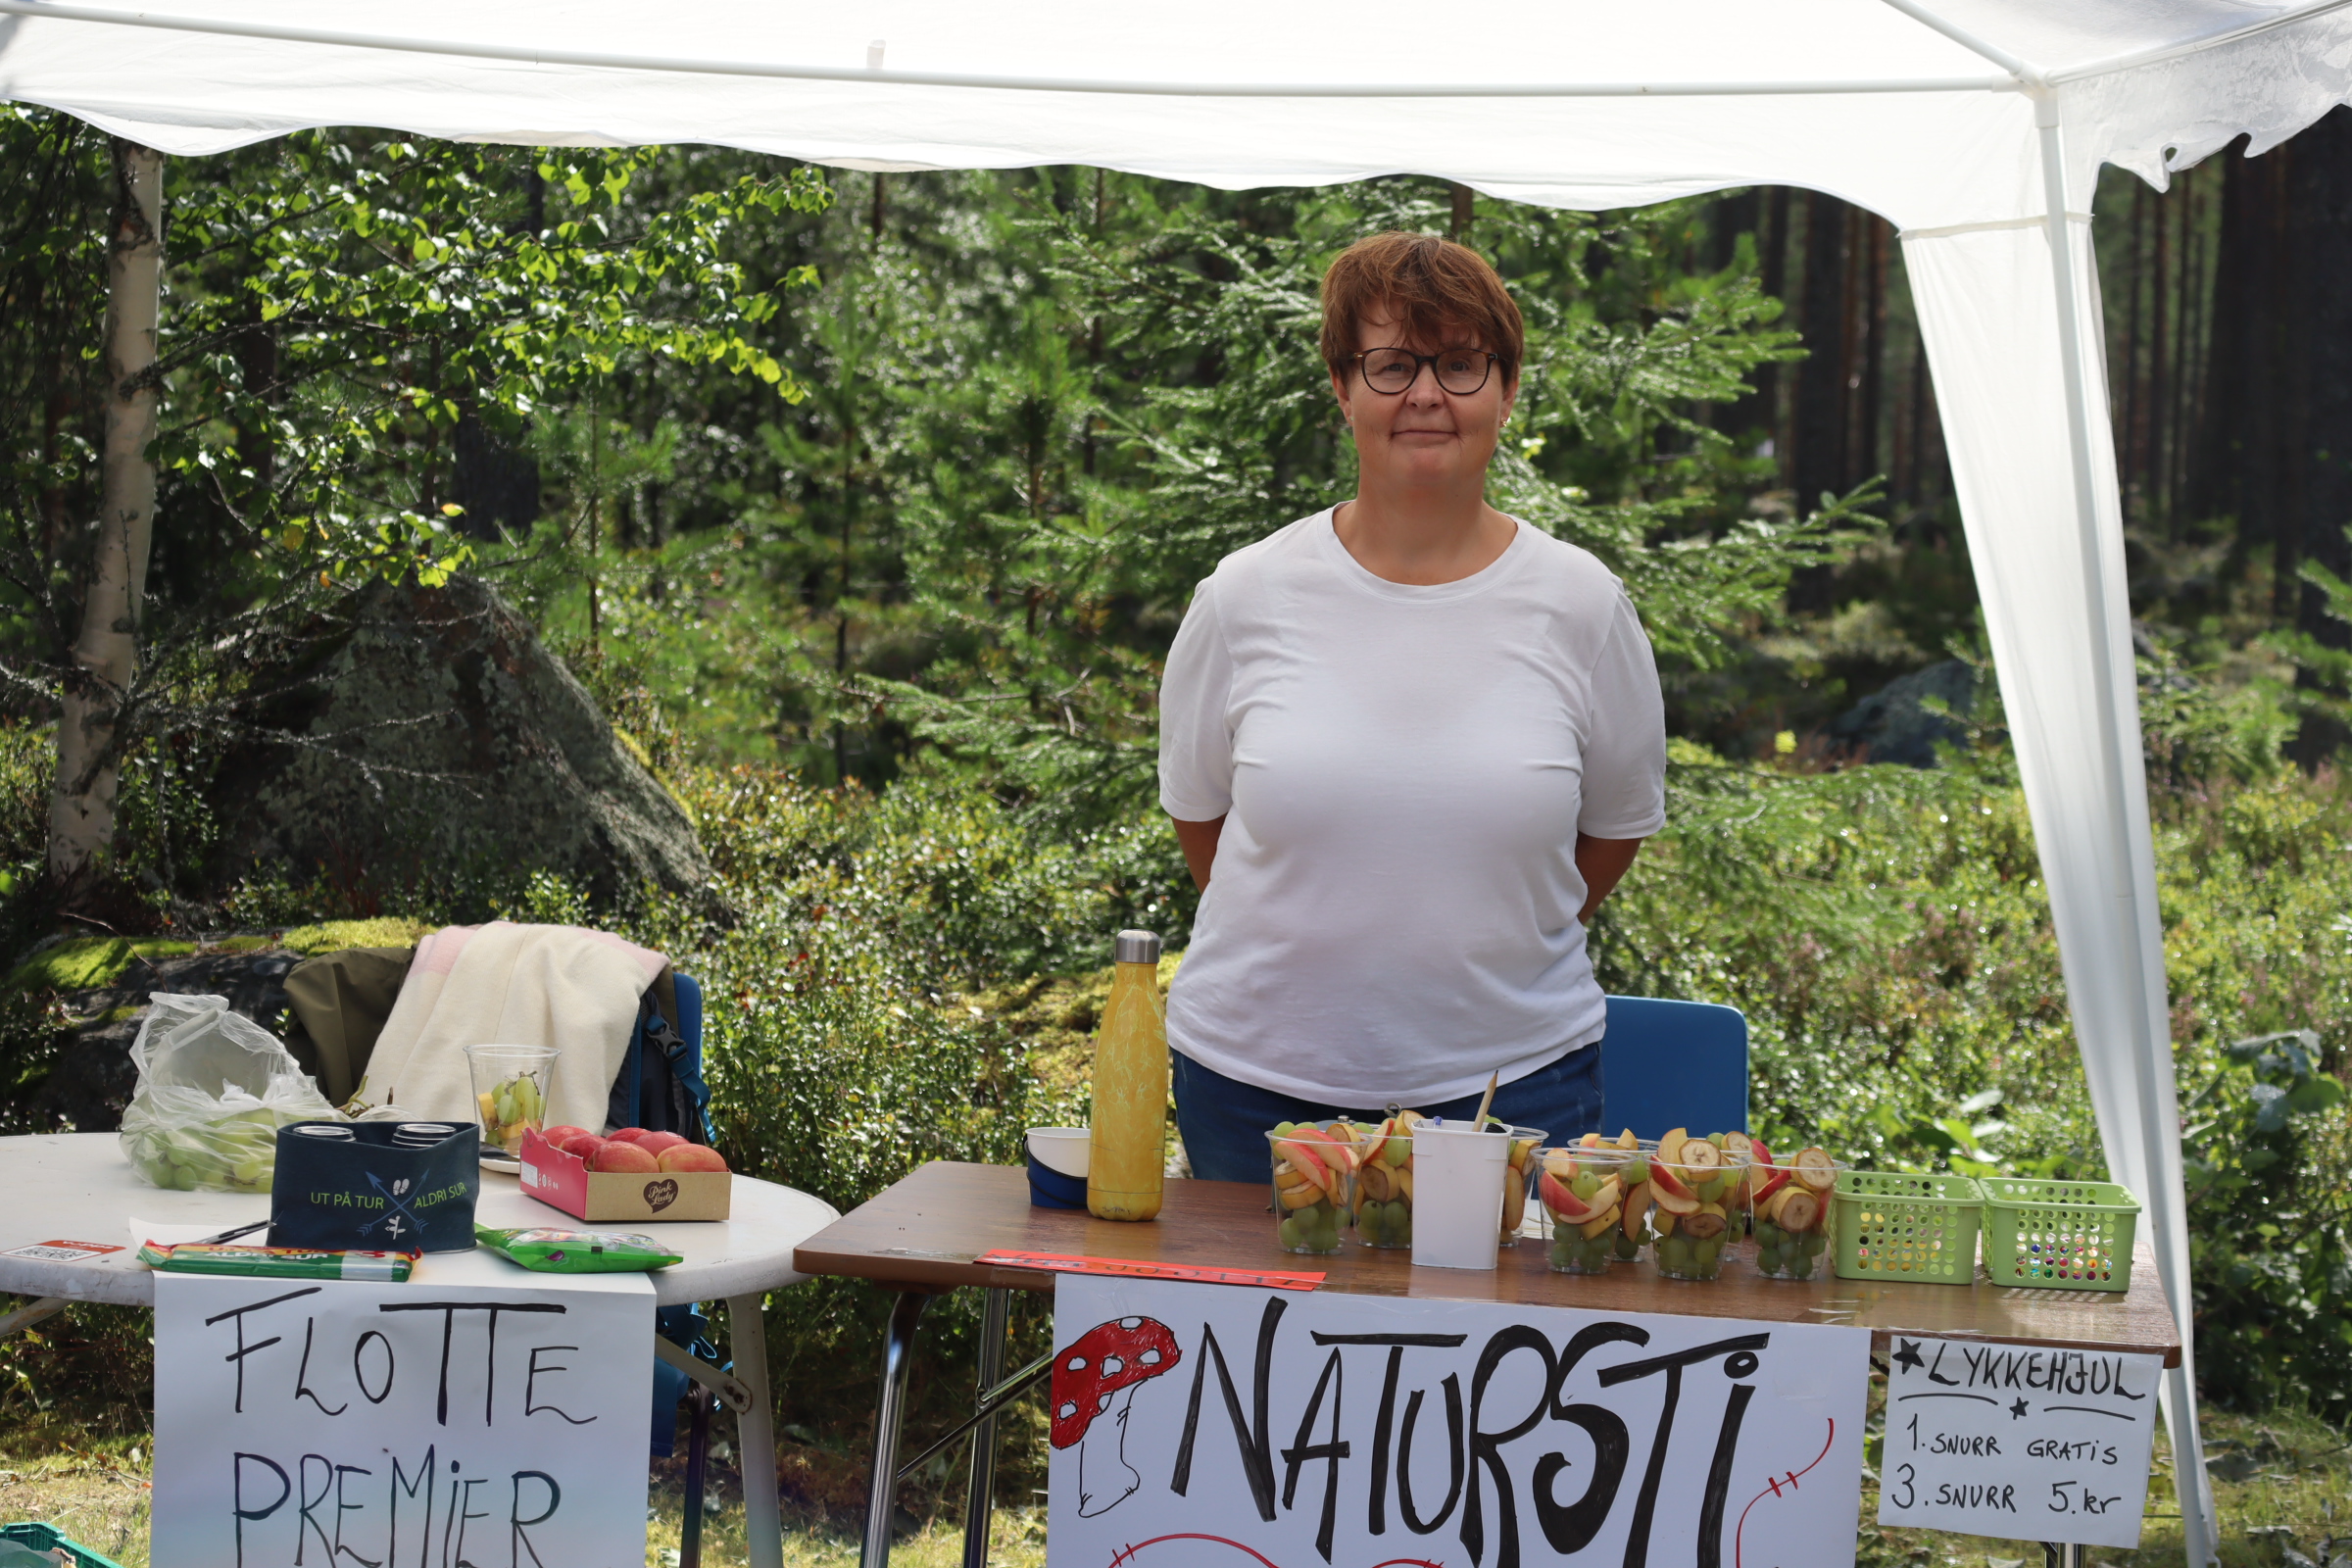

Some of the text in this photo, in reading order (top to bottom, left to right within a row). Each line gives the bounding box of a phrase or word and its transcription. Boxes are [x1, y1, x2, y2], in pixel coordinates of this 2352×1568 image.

[311, 1191, 384, 1209] UT PÅ TUR
[414, 1182, 467, 1209] ALDRI SUR
[648, 1181, 672, 1199] Pink
[651, 1192, 674, 1206] Lady
[205, 1287, 598, 1427] FLOTTE
[1928, 1342, 2146, 1400] LYKKEHJUL
[1931, 1433, 2001, 1456] SNURR
[1936, 1483, 2017, 1513] SNURR
